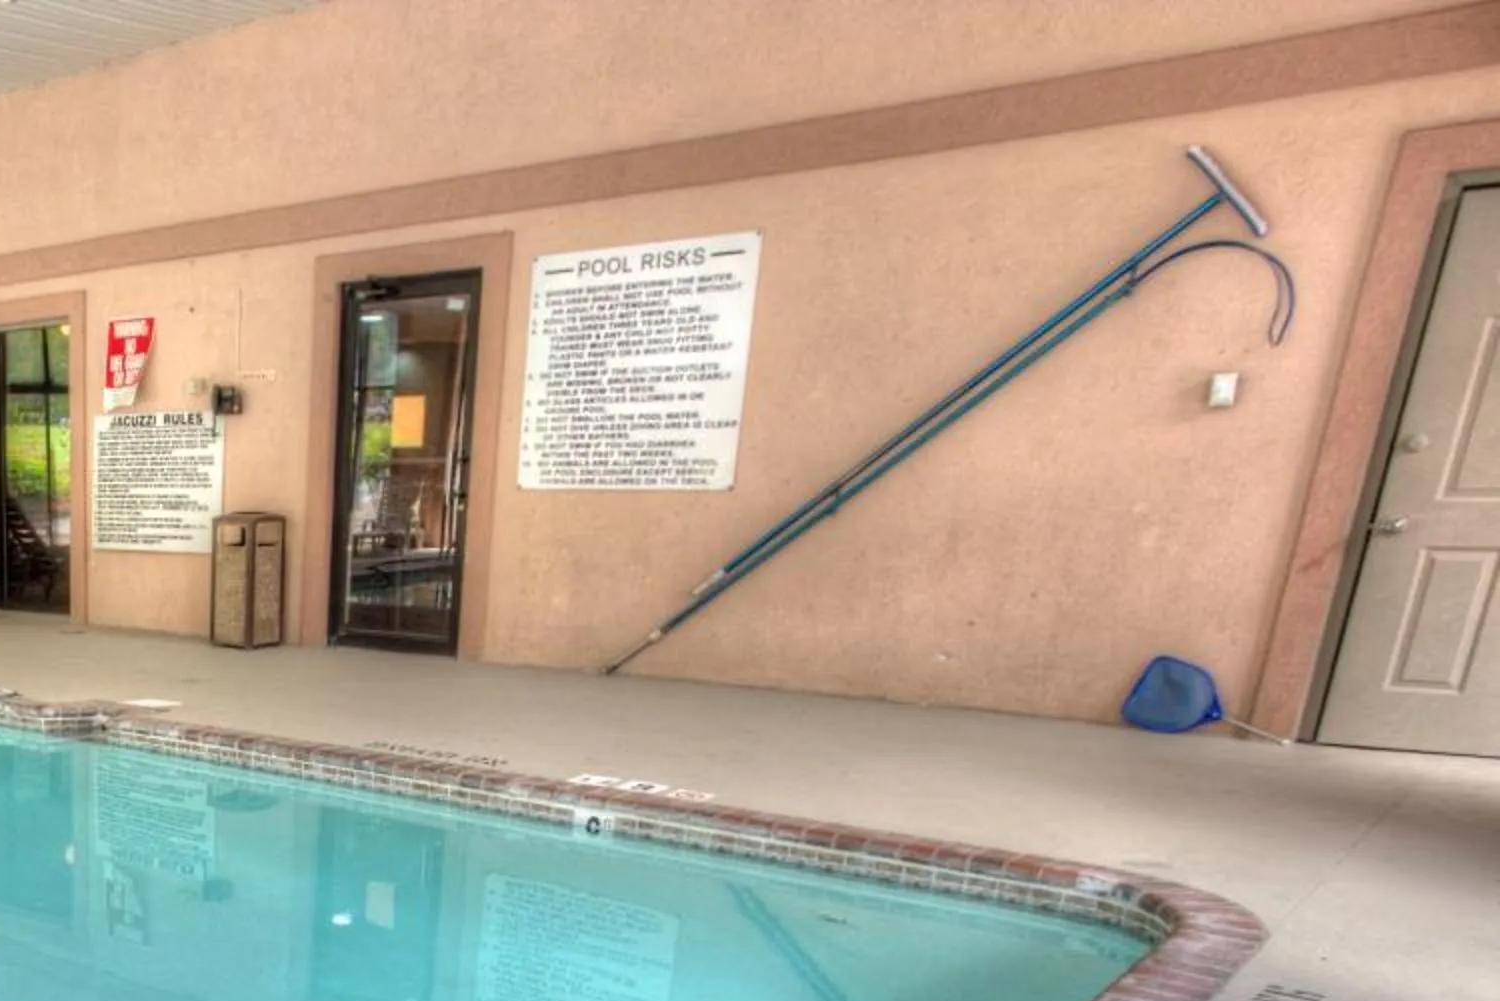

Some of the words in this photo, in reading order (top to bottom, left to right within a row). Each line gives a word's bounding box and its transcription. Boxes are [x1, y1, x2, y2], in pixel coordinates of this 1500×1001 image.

[578, 256, 633, 278] POOL
[640, 247, 706, 270] RISKS
[584, 283, 623, 294] BEFORE
[623, 278, 674, 290] ENTERING
[675, 275, 696, 285] THE
[544, 296, 589, 307] CHILDREN
[590, 293, 619, 303] SHALL
[622, 291, 642, 300] NOT
[644, 289, 664, 298] USE
[666, 286, 692, 296] POOL
[695, 281, 741, 293] WITHOUT
[542, 316, 577, 326] ADULTS
[578, 312, 616, 322] SHOULD
[617, 310, 637, 319] NOT
[639, 308, 665, 317] SWIM
[565, 305, 594, 314] ADULT
[542, 326, 557, 334] ALL
[561, 322, 606, 333] CHILDREN
[608, 320, 638, 329] THREE
[641, 317, 673, 327] YEARS
[675, 315, 696, 324] OLD
[697, 313, 719, 322] AND
[550, 332, 593, 343] YOUNGER
[602, 330, 622, 339] ANY
[624, 328, 653, 337] CHILD
[654, 326, 674, 335] NOT
[676, 323, 709, 333] POTTY
[550, 342, 587, 352] TRAINED
[588, 340, 613, 349] MUST
[615, 338, 644, 347] WEAR
[674, 333, 714, 343] FITTING
[547, 351, 584, 361] PLASTIC
[586, 349, 617, 358] PANTS
[642, 345, 676, 355] WATER
[677, 341, 732, 352] RESISTANT
[548, 361, 571, 370] SWIM
[553, 370, 572, 378] NOT
[574, 369, 598, 377] SWIM
[610, 367, 628, 375] THE
[630, 364, 673, 374] SUCTION
[674, 362, 720, 372] OUTLETS
[546, 380, 563, 388] ARE
[606, 376, 646, 385] BROKEN
[663, 374, 684, 382] NOT
[685, 371, 731, 381] CLEARLY
[544, 388, 579, 396] VISIBLE
[579, 387, 608, 395] FROM
[608, 386, 627, 394] THE
[552, 397, 581, 405] GLASS
[582, 395, 627, 404] ARTICLES
[628, 393, 674, 402] ALLOWED
[689, 392, 704, 400] OR
[110, 415, 157, 427] JACUZZI
[163, 413, 203, 425] RULES
[550, 415, 568, 423] NOT
[570, 414, 616, 422] SWALLOW
[617, 413, 635, 421] THE
[636, 412, 662, 420] POOL
[550, 424, 567, 432] NOT
[591, 423, 628, 431] UNLESS
[628, 422, 662, 430] DIVING
[662, 421, 690, 429] AREA
[555, 432, 586, 440] OTHER
